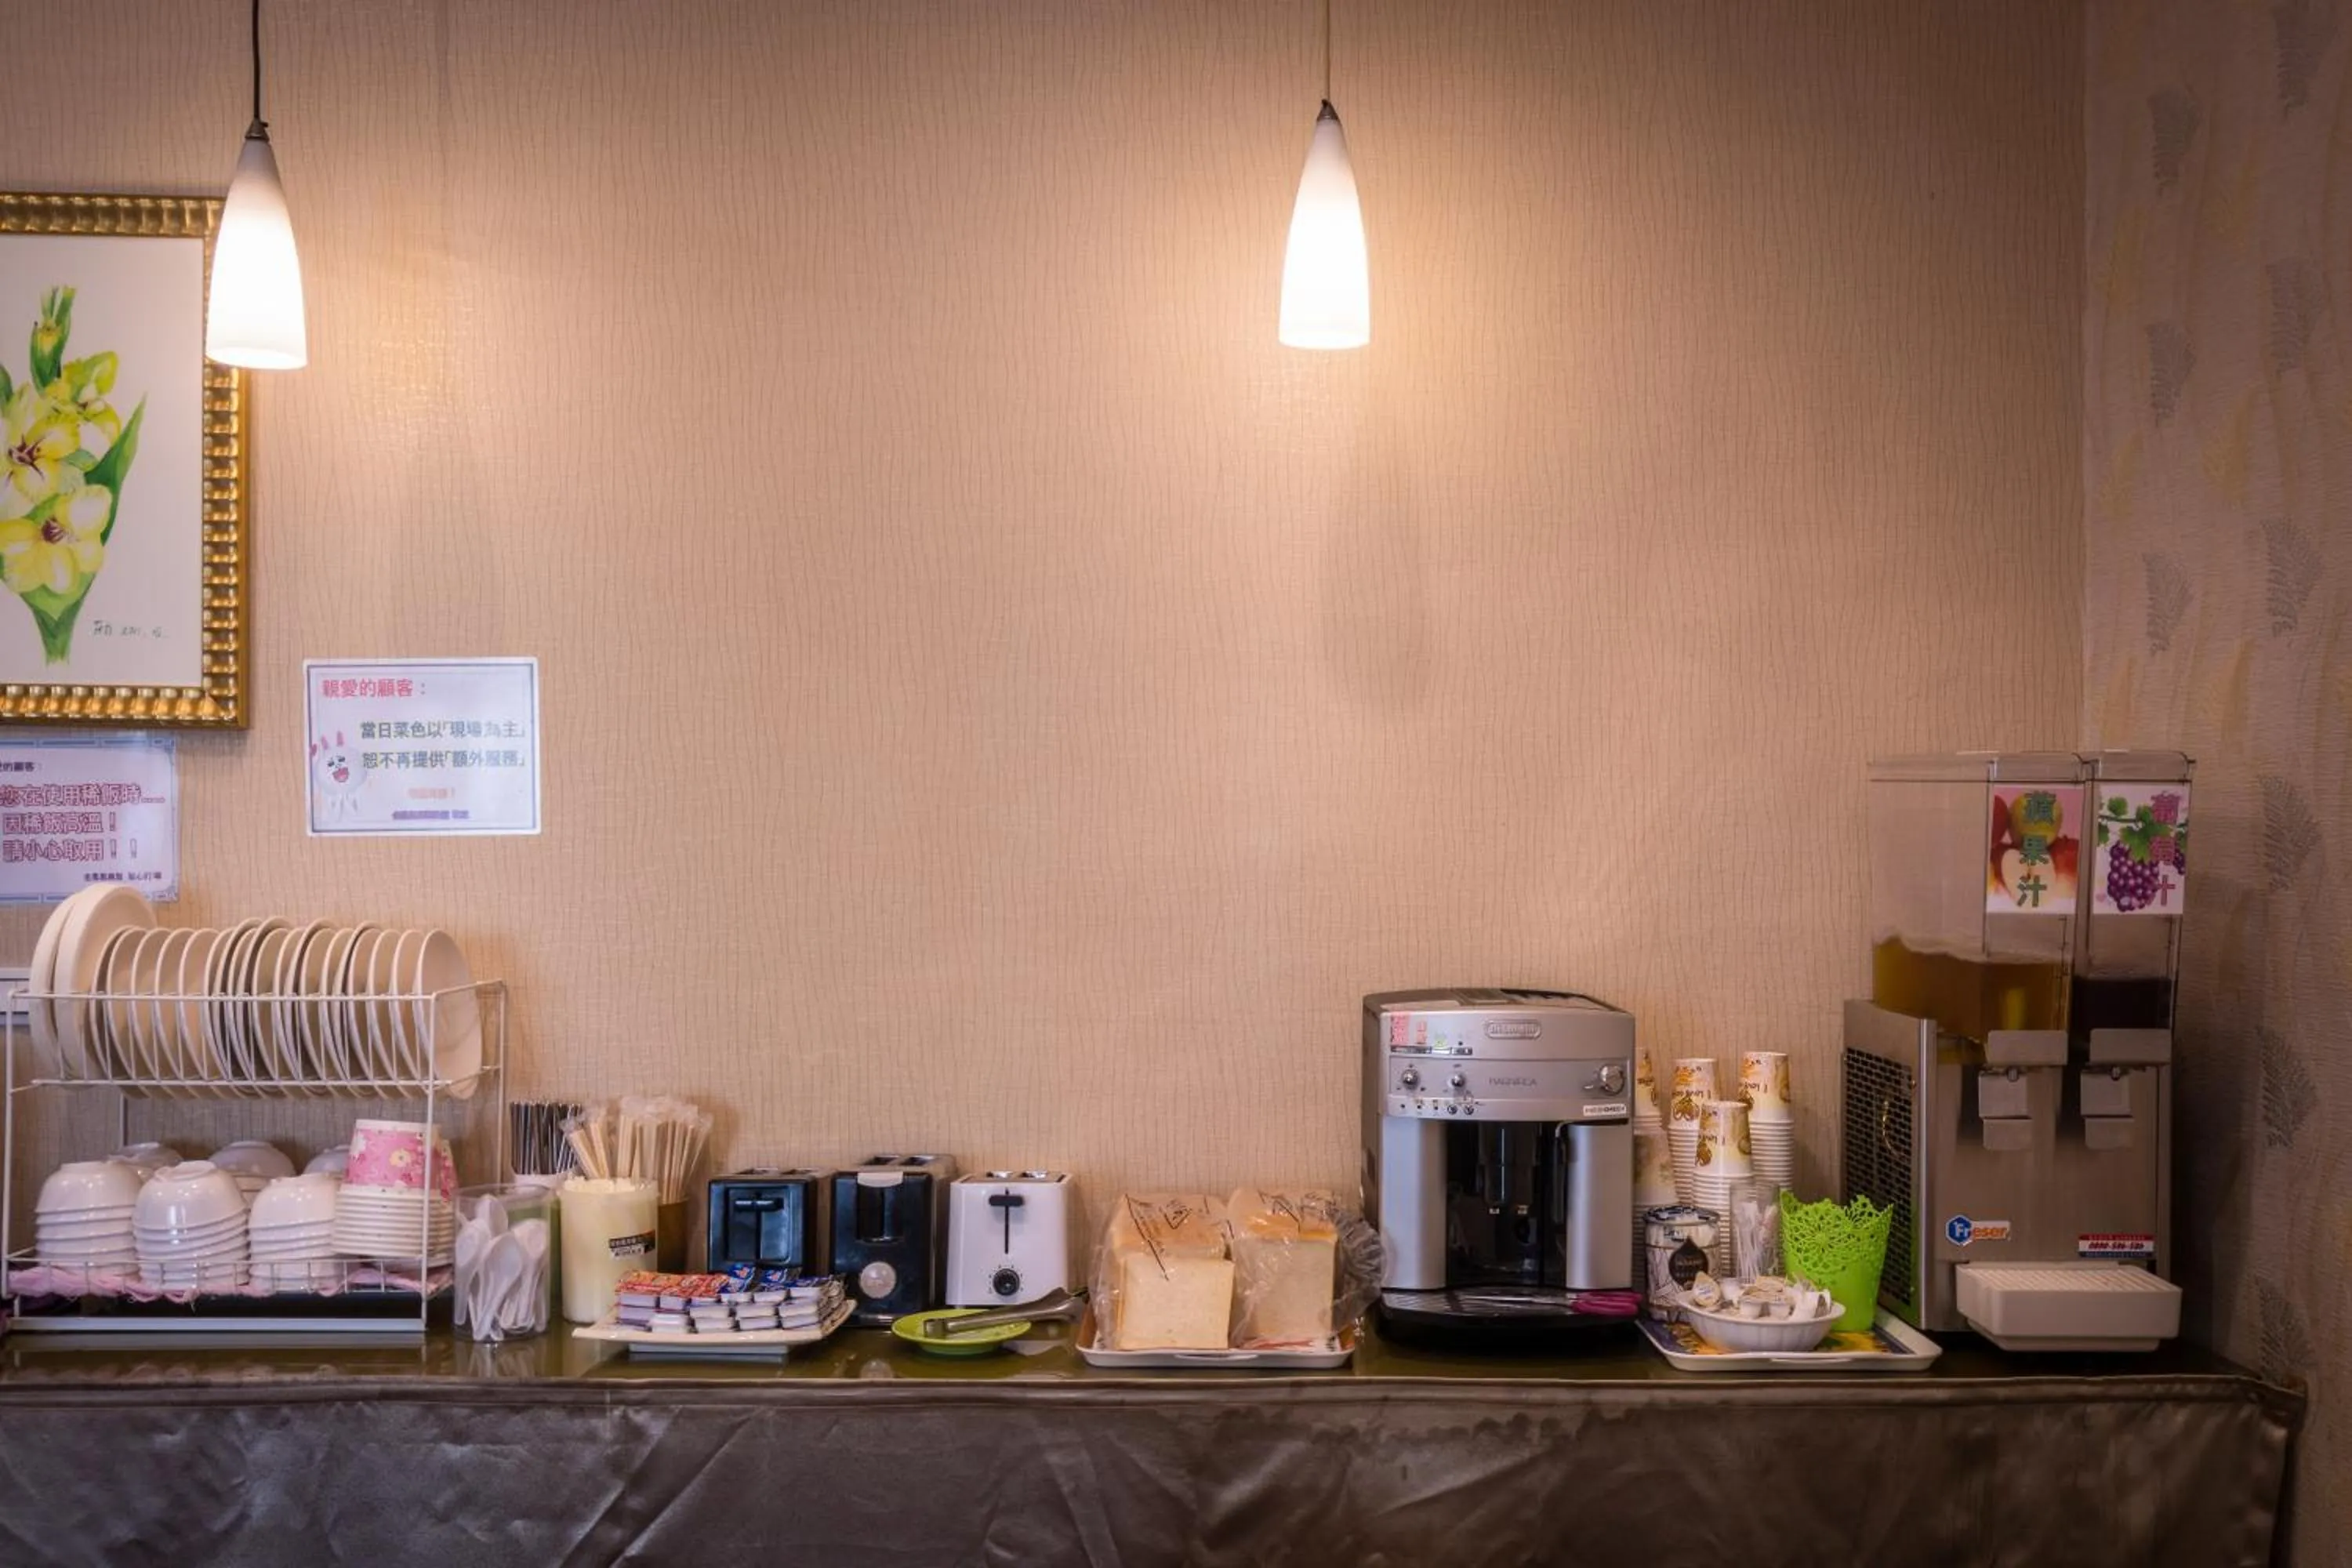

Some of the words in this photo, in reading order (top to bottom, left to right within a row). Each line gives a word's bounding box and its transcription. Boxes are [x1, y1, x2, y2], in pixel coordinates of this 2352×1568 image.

[322, 678, 426, 698] 親愛的顧客：
[2016, 790, 2056, 907] 蘋果汁
